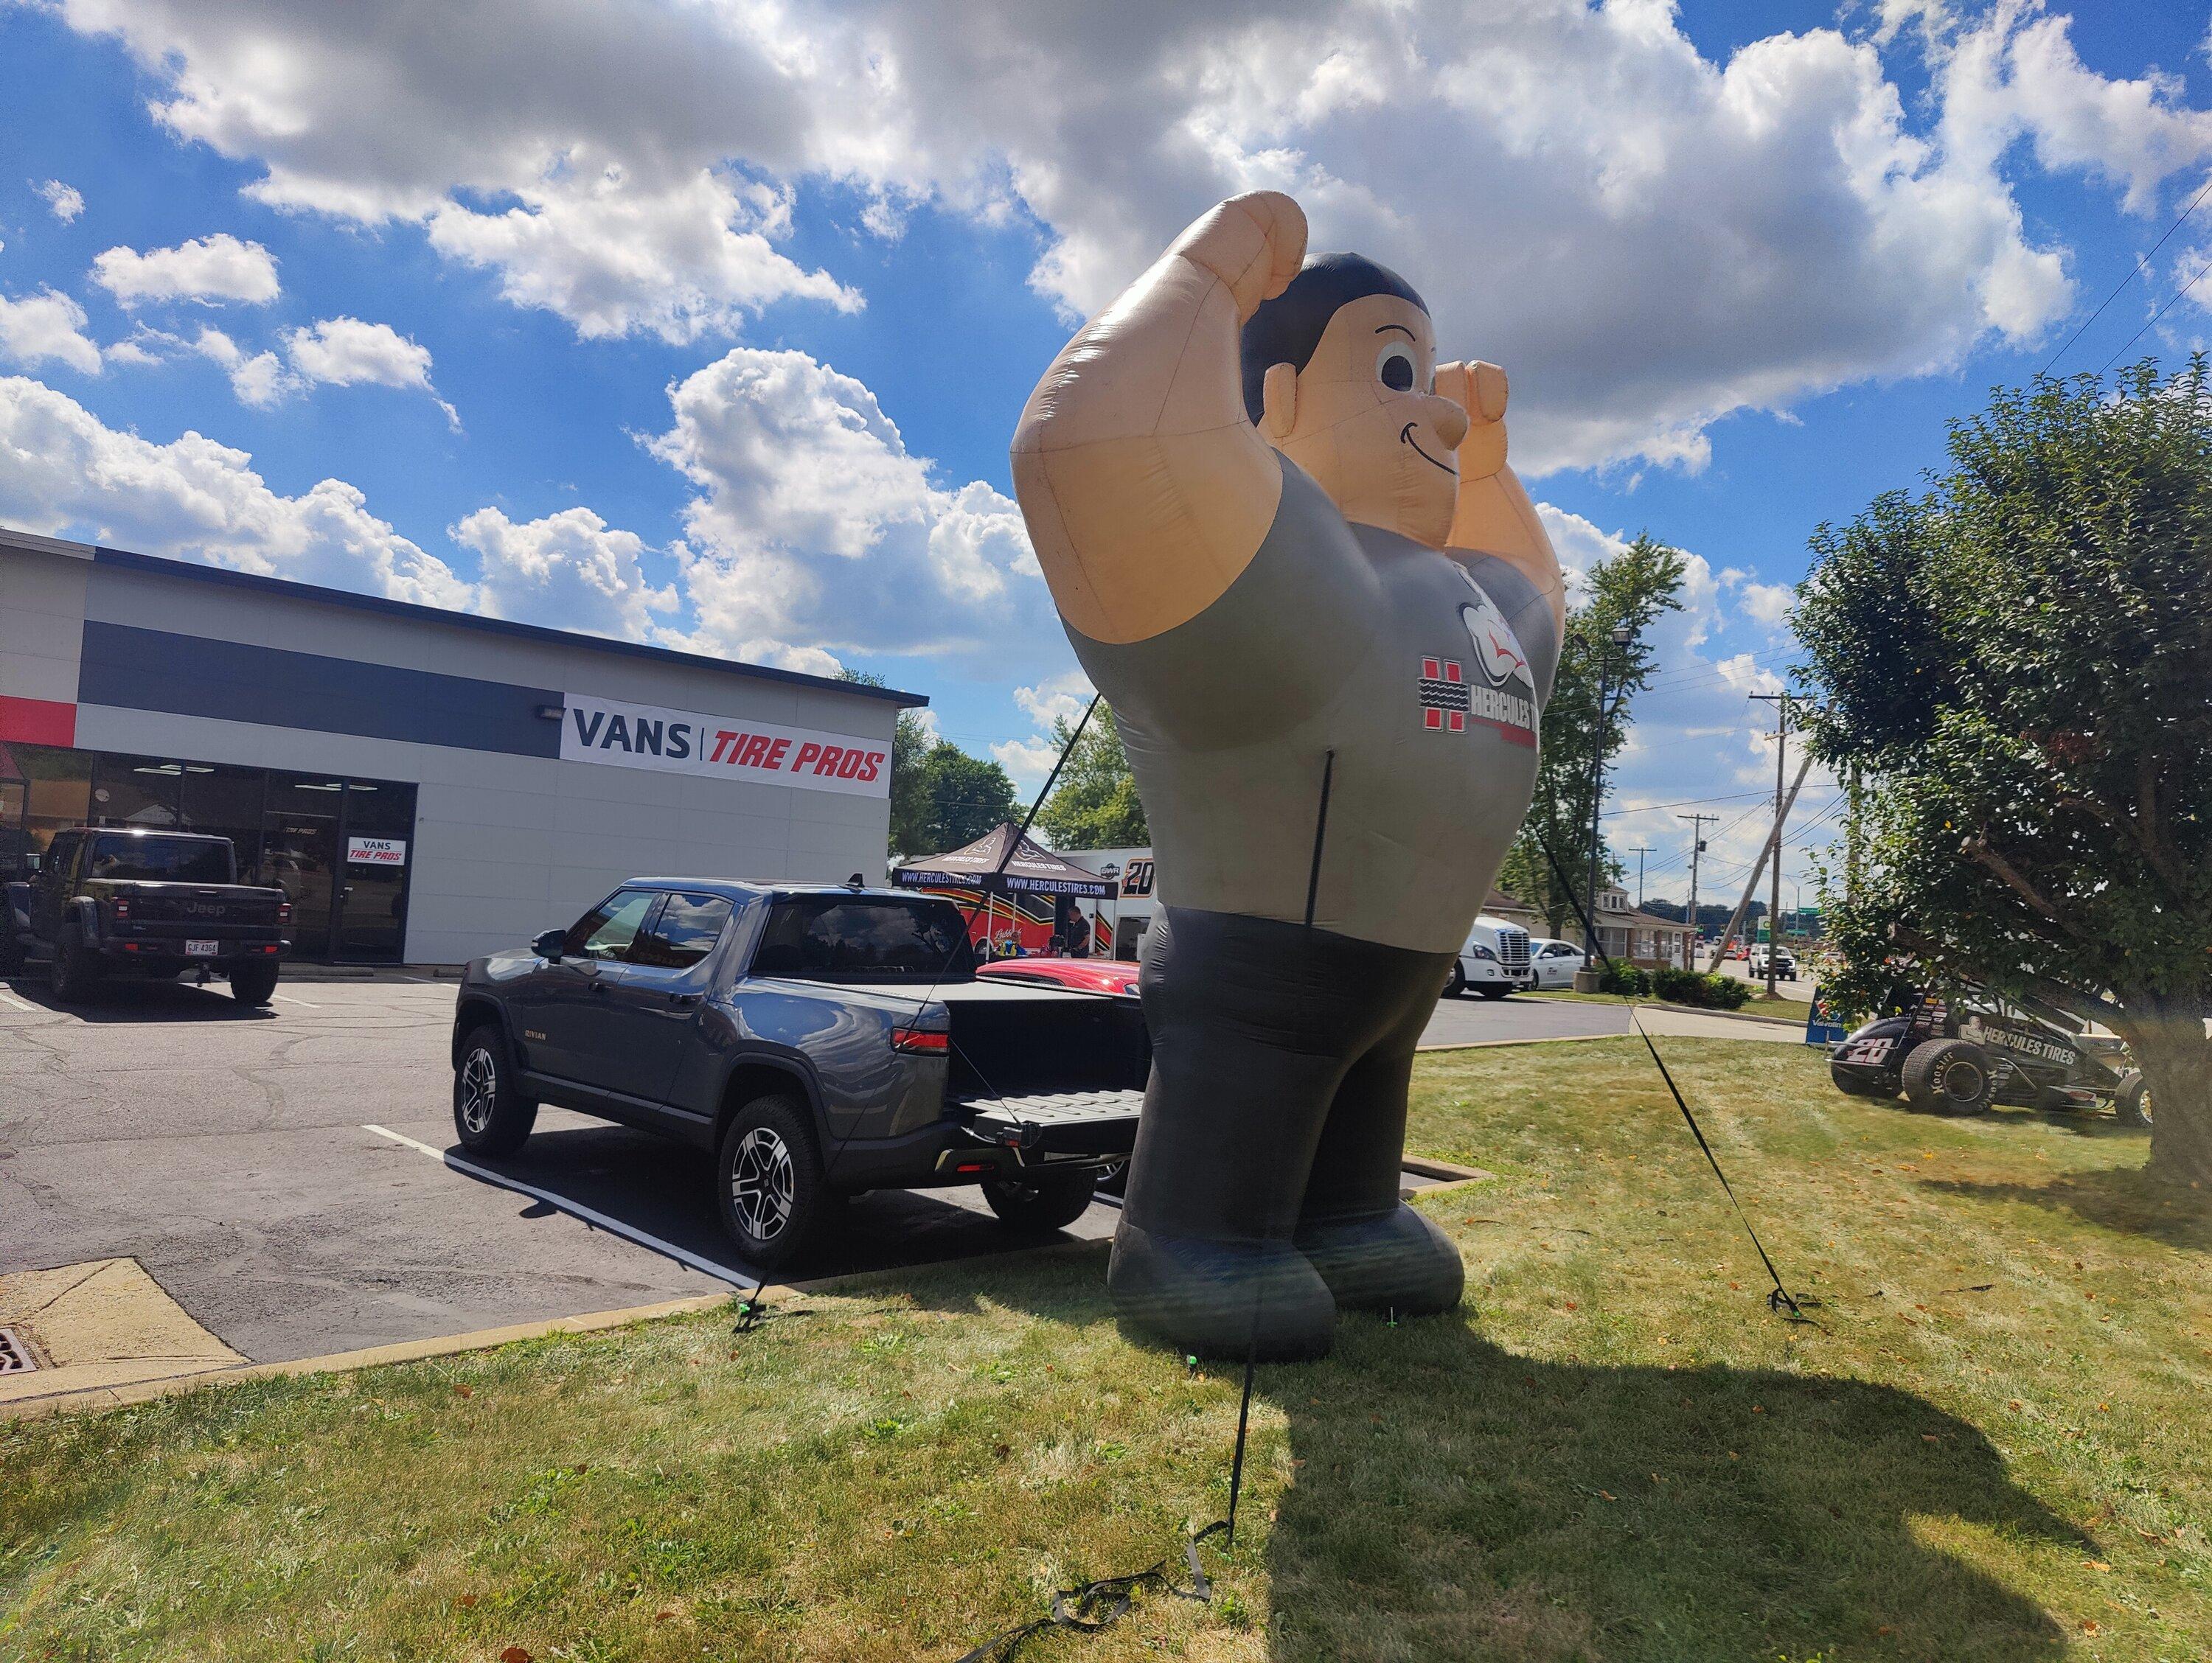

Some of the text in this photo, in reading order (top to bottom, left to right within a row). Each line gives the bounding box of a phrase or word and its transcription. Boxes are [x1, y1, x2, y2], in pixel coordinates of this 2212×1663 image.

[1471, 684, 1531, 730] HERCULES
[573, 708, 886, 782] VANS TIRE PROS
[364, 840, 391, 850] VANS
[349, 849, 403, 861] TIRE PROS
[902, 872, 982, 885] WWW.HERCULESTIRES.COM
[1006, 877, 1106, 895] WWW.HERCULESTIRES.COM
[1123, 862, 1155, 895] 20
[187, 901, 226, 917] Jeep
[1812, 1018, 1843, 1028] Valvolin
[525, 1029, 546, 1041] RIVIAN
[1846, 1037, 1894, 1064] 20
[1983, 1025, 2076, 1066] HERCULES TIRES
